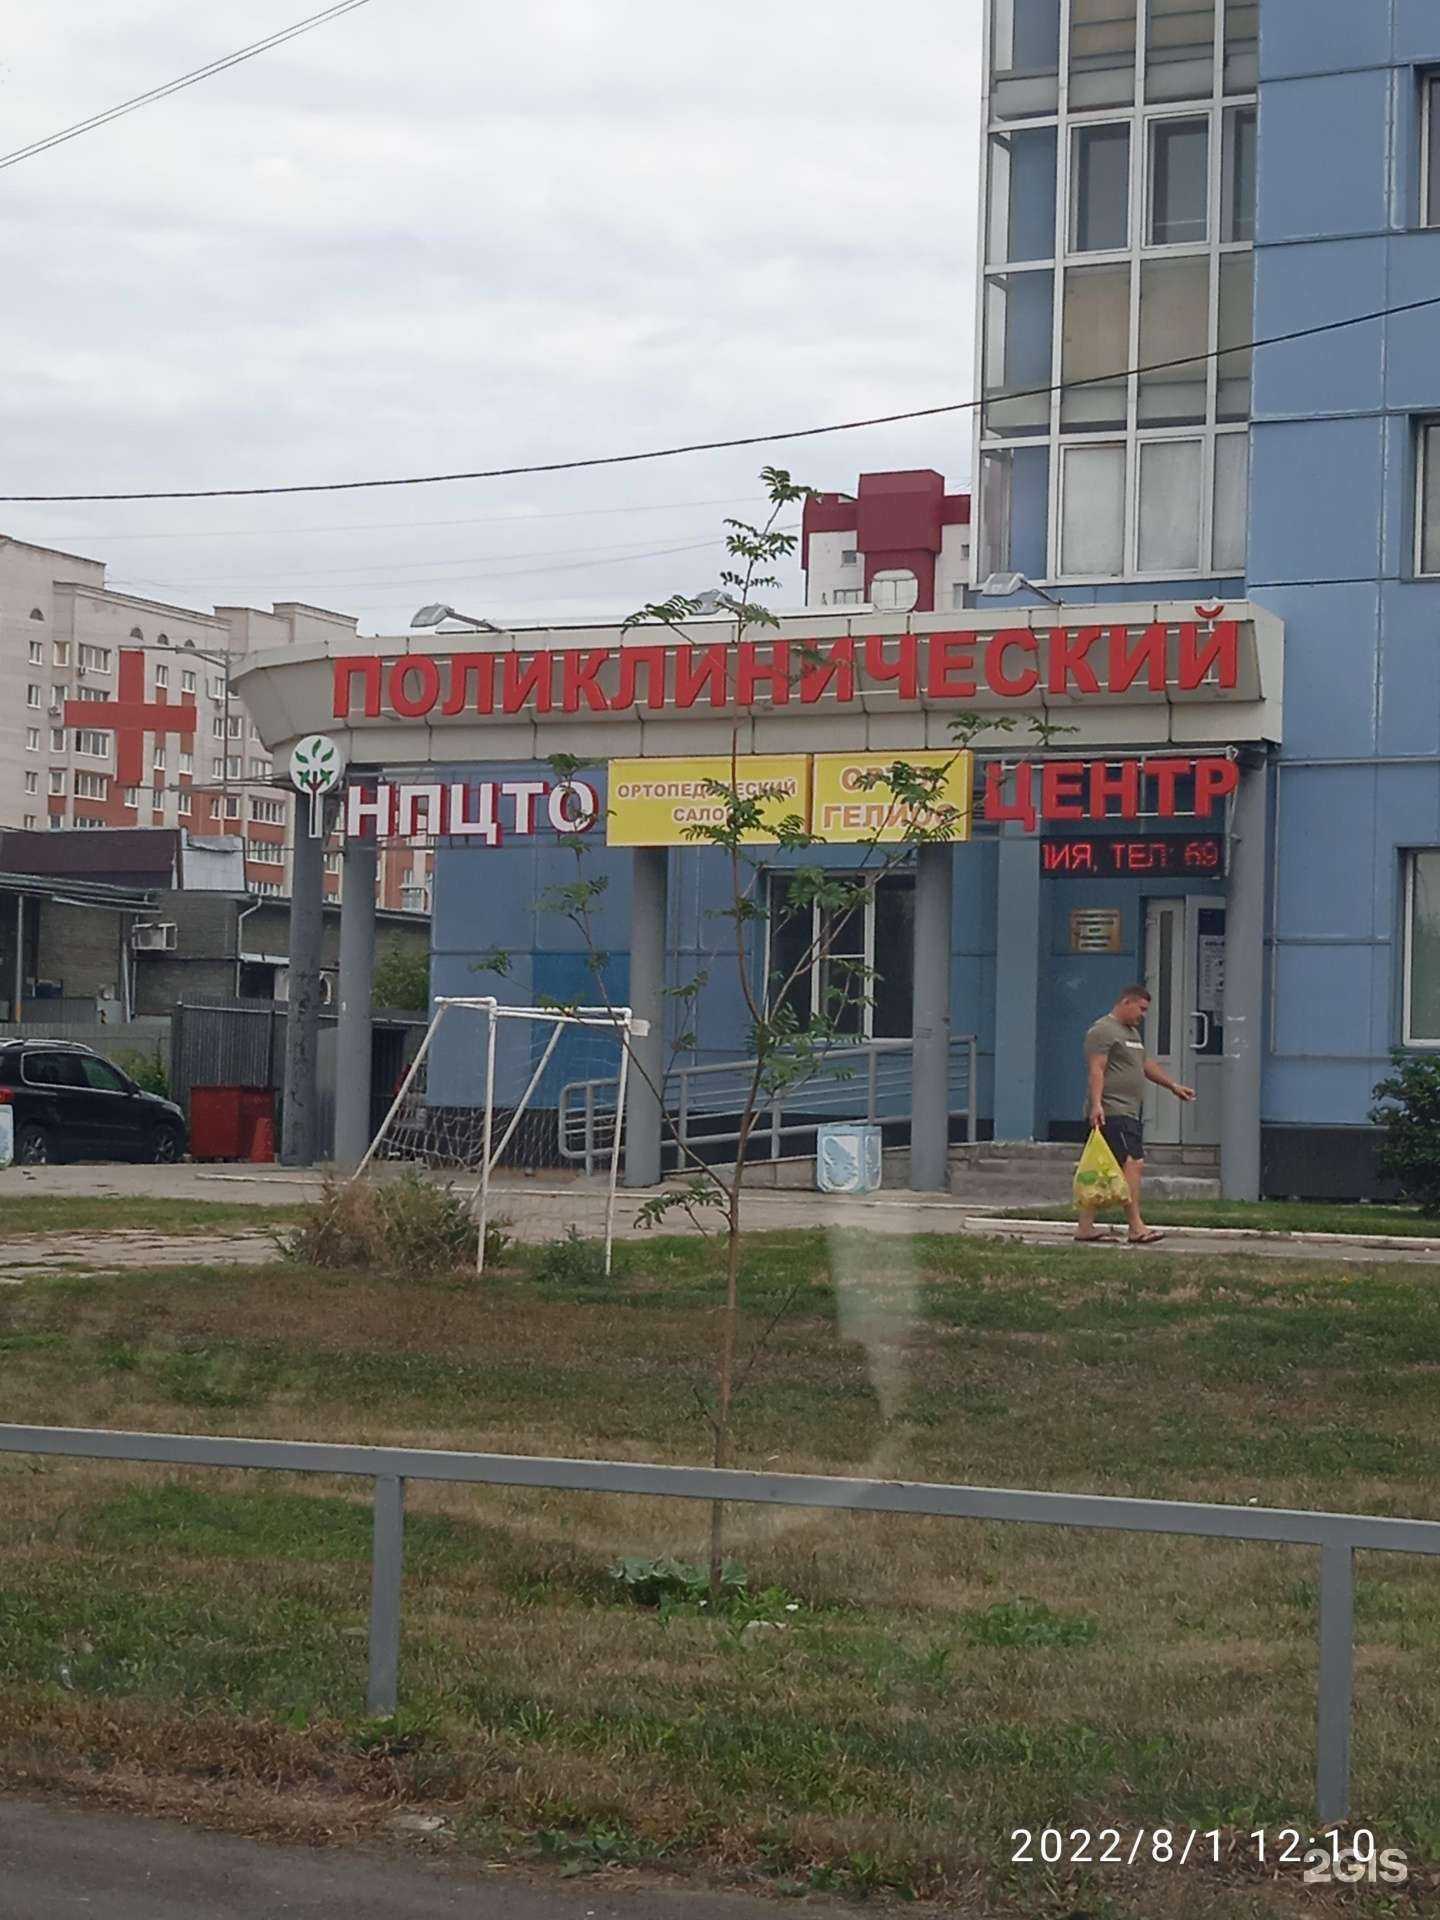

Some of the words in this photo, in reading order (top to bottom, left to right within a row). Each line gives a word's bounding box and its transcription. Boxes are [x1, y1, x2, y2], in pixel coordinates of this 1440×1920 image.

[333, 605, 1239, 718] ПОЛИКЛИНИЧЕСКИЙ
[618, 779, 796, 799] ОРТОПЕДЕСКИЙ
[841, 766, 944, 791] ОР
[984, 757, 1240, 832] ЦЕНТР
[347, 780, 599, 847] НПЦТО
[673, 807, 740, 822] САЛО
